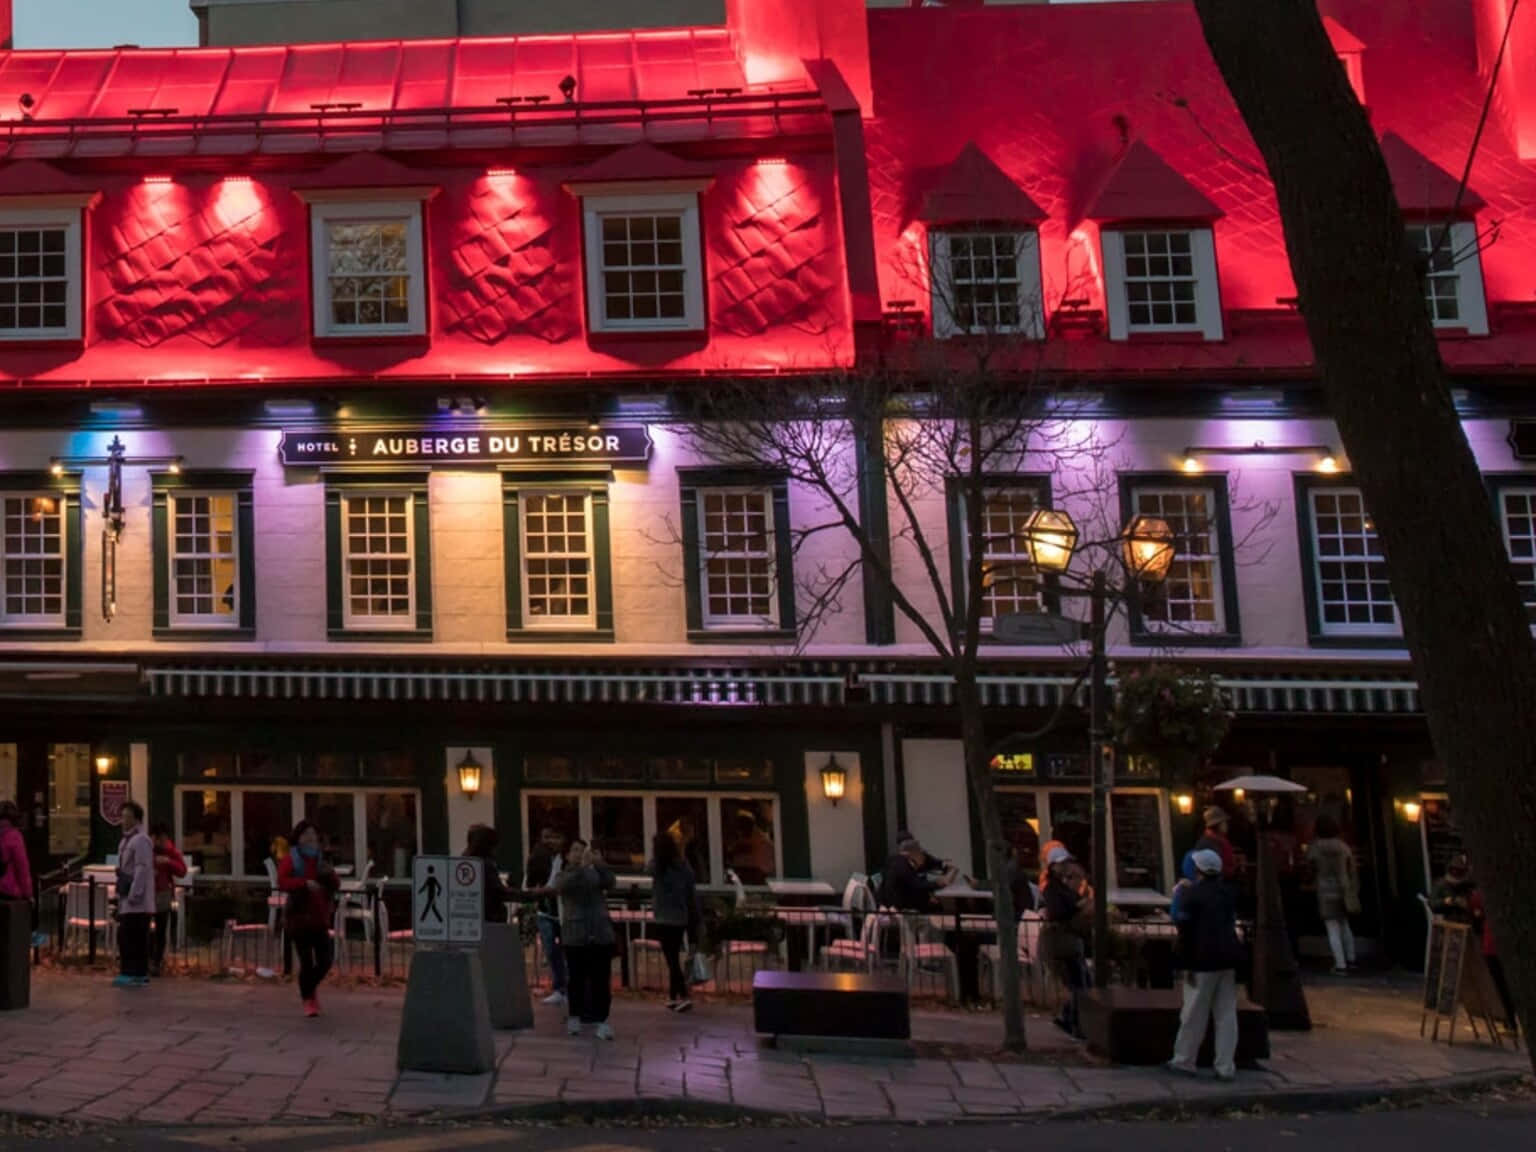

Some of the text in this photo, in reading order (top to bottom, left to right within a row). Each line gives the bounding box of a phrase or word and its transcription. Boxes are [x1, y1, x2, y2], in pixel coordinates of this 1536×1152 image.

[297, 432, 620, 454] HOTEL AUBERGE DU TRÉSOR
